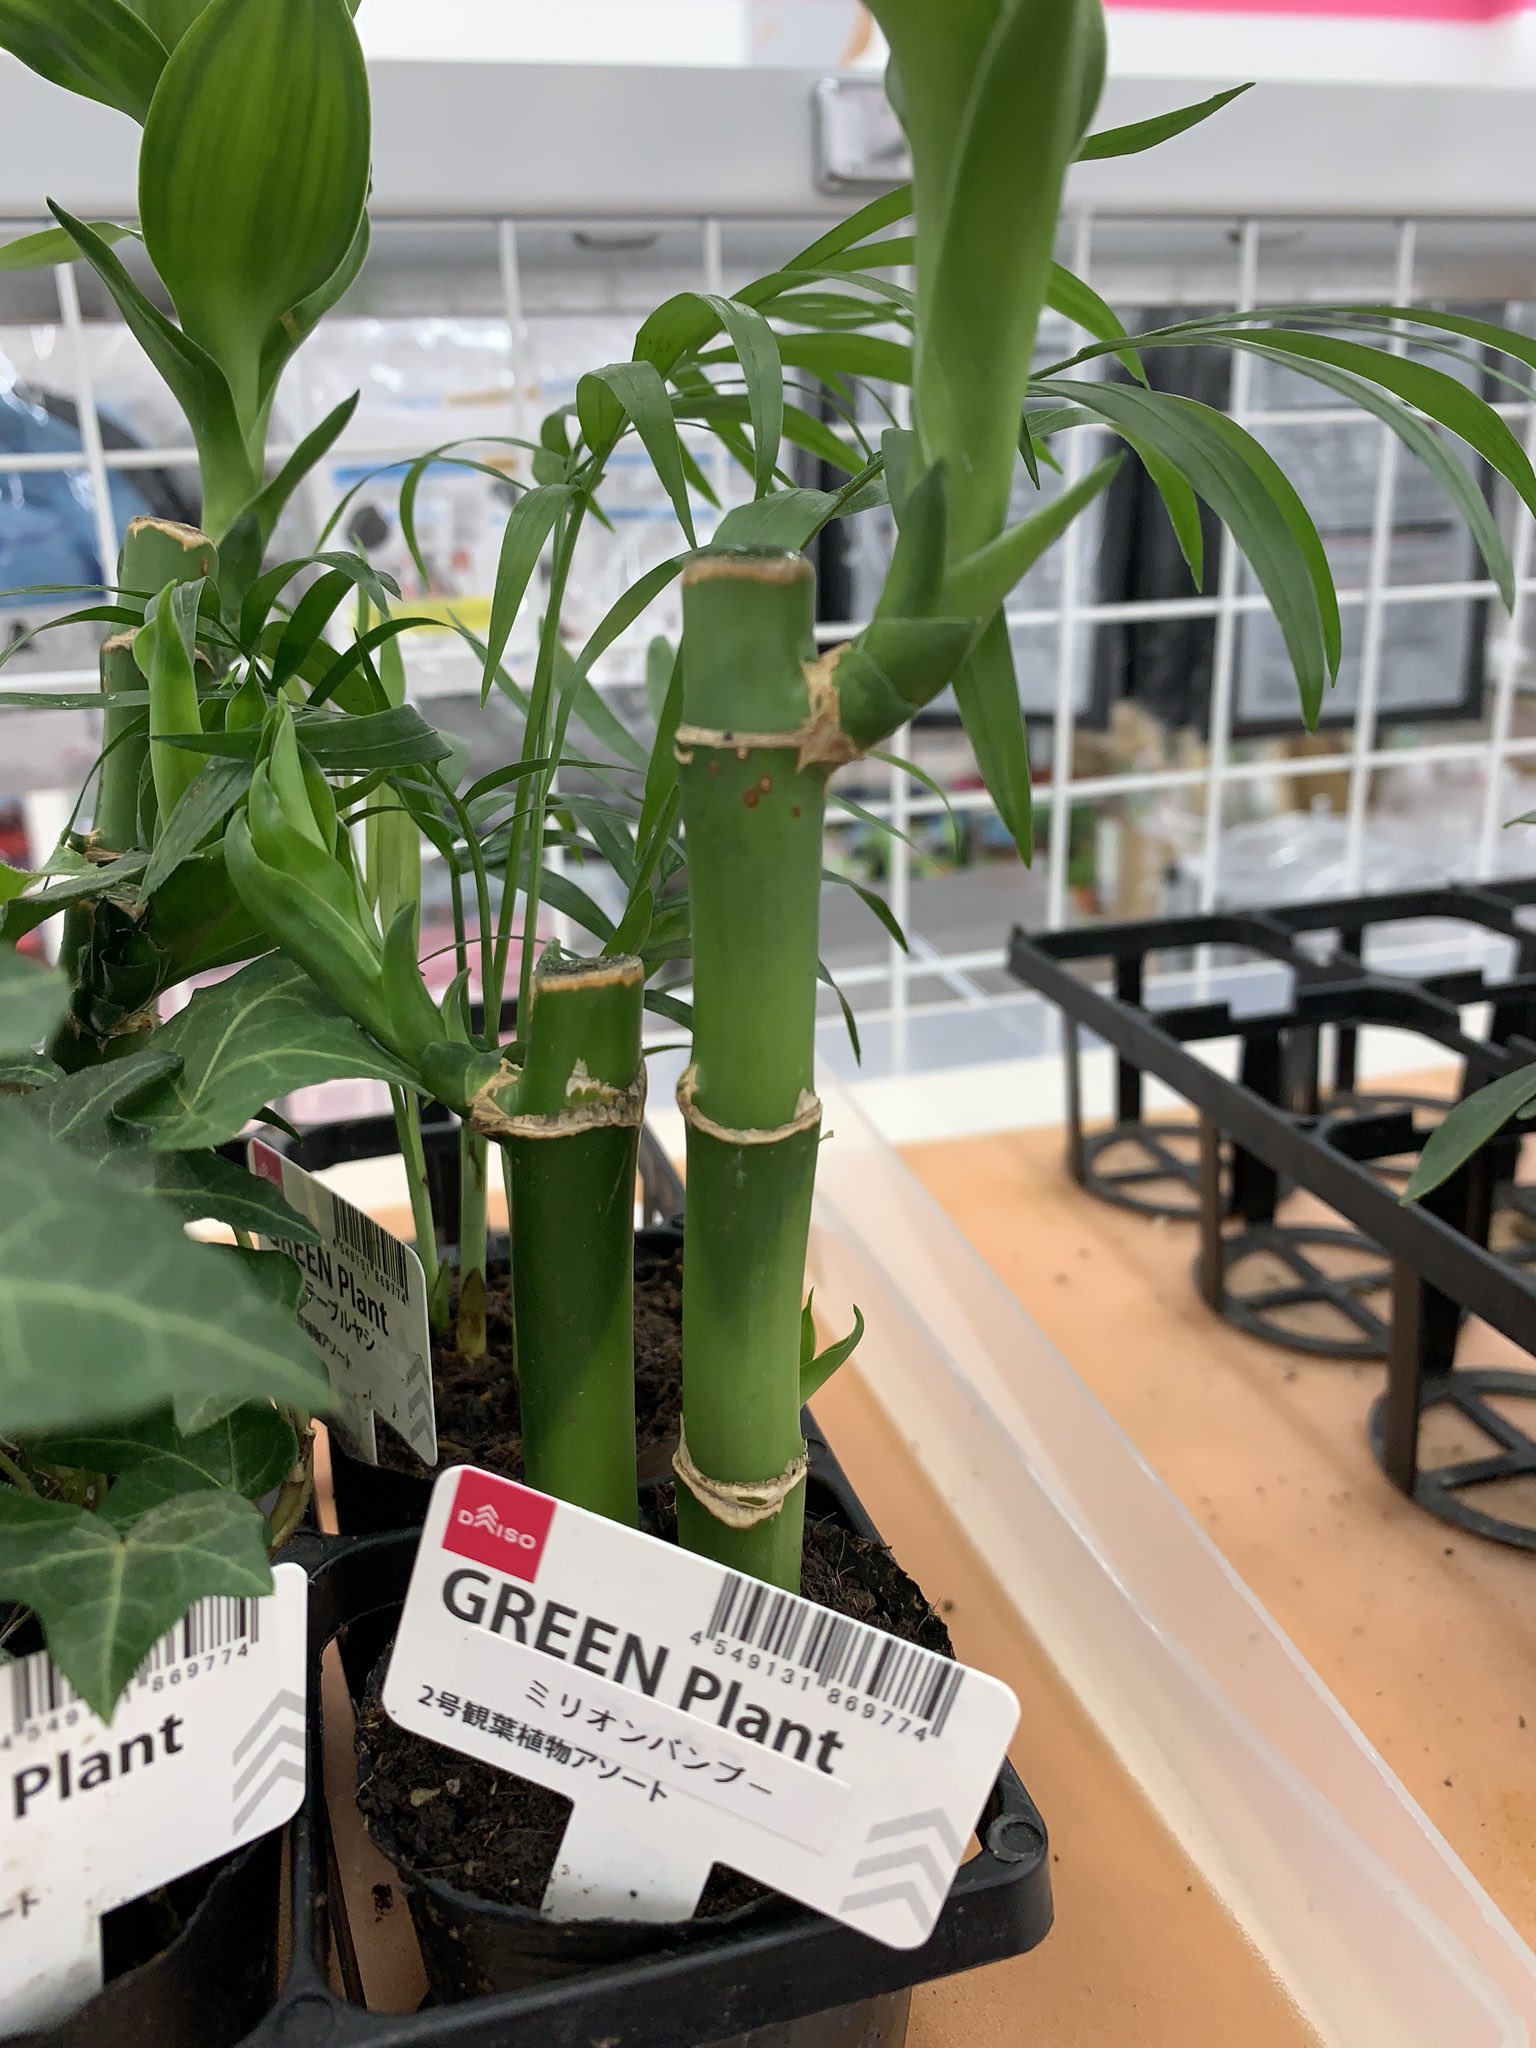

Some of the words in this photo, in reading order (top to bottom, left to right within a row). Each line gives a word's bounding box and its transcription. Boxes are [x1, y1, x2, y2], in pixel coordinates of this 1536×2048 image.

[337, 1263, 389, 1336] Plant
[458, 1504, 537, 1550] DAISO
[442, 1567, 669, 1697] GREEN
[678, 1666, 843, 1775] Plant
[13, 1713, 184, 1819] Plant
[417, 1684, 668, 1802] 2号観葉植物アソート
